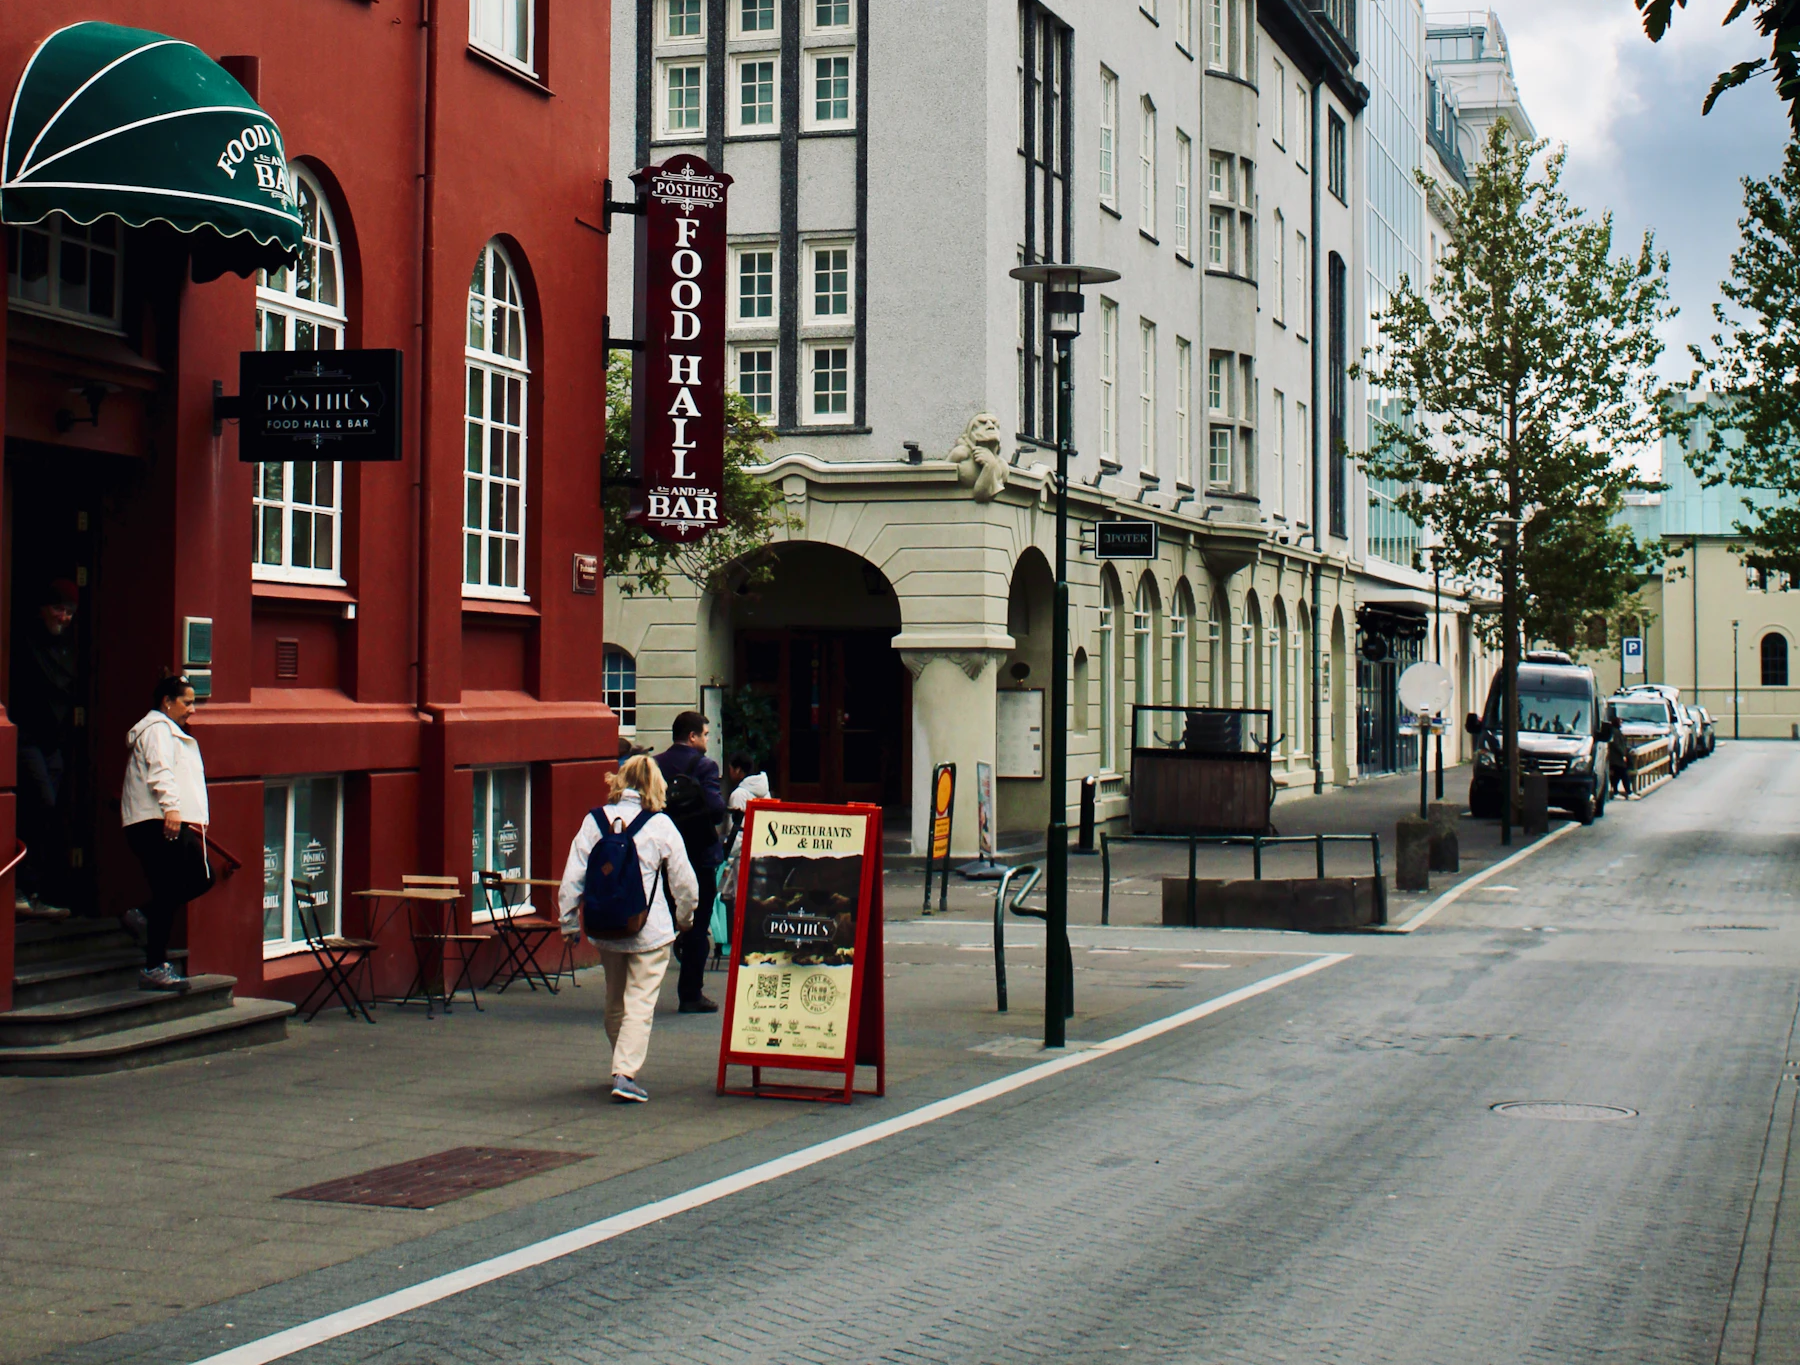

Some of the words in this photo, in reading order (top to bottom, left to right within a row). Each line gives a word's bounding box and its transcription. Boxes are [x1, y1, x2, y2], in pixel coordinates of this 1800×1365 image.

[217, 124, 272, 180] FOOD
[656, 180, 719, 199] PÓSTHÚS
[670, 217, 703, 341] FOOD
[266, 388, 370, 411] PÓSTHÚS
[266, 419, 299, 429] FOOD
[303, 419, 331, 429] HALL
[335, 419, 342, 429] &
[347, 418, 369, 428] BAR
[667, 354, 703, 480] HALL
[670, 486, 697, 497] AND
[647, 494, 719, 520] BAR
[1629, 643, 1638, 654] P
[765, 820, 779, 847] 8
[781, 824, 852, 838] RESTAURANTS
[797, 837, 808, 849] &
[812, 838, 833, 850] BAR
[770, 919, 829, 936] PÓSTHÚS
[779, 973, 792, 1010] MENUS
